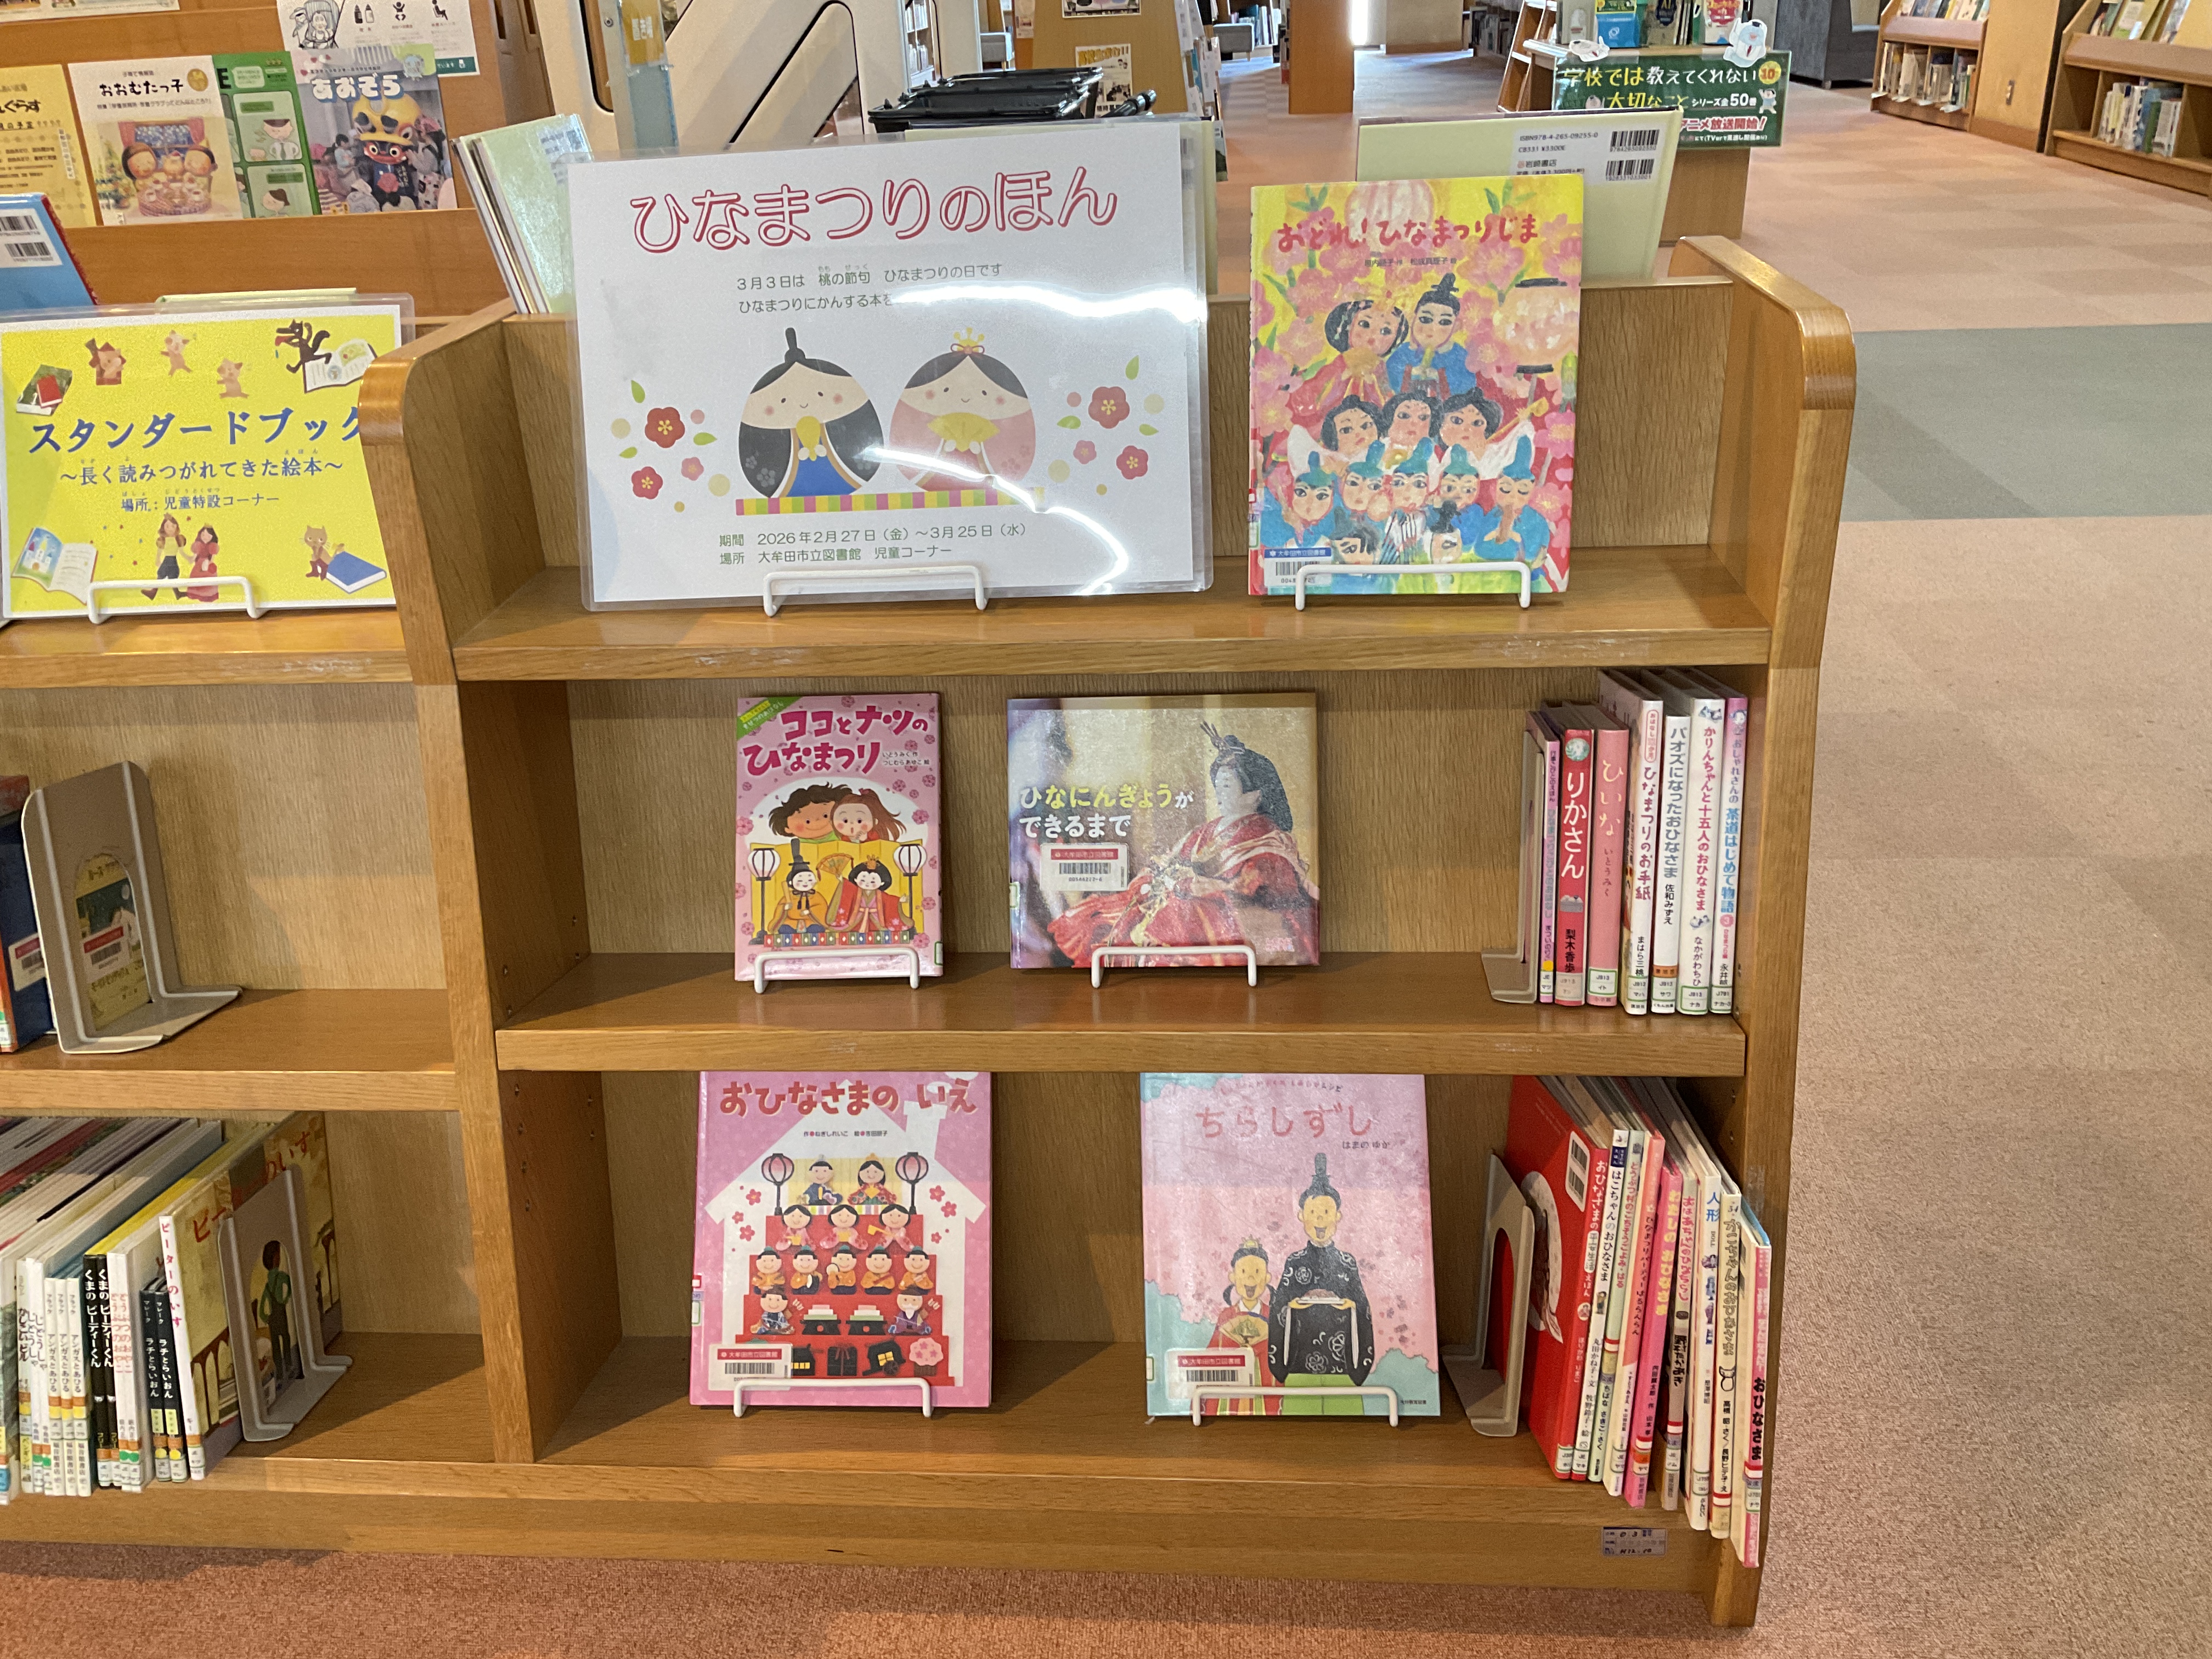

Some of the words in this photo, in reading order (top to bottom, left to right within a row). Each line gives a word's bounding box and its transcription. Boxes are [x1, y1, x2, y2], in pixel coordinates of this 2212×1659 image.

[99, 79, 183, 97] おおむたっ子
[311, 72, 402, 103] あおぞら
[1519, 132, 1599, 142] ISBN978-4-265-09255-0
[630, 166, 1118, 253] ひなまつりのほん
[737, 274, 805, 291] 3月3日は
[817, 269, 871, 287] 桃の節句
[884, 263, 1002, 283] ひなまつりの日です
[719, 533, 745, 547] 期間
[719, 551, 745, 566] 場所
[757, 548, 862, 563] 大牟田市立図書館
[873, 545, 952, 560] 児童コーナー
[781, 704, 928, 742] ココとナツの
[742, 741, 881, 776] ひなまつり
[1020, 783, 1194, 810] ひなにんぎょうが
[1598, 760, 1624, 837] ひいな
[1663, 727, 1688, 878] パオズになったおひなさま
[1019, 812, 1131, 839] できるまで
[1561, 771, 1588, 879] りかさん
[1635, 767, 1657, 900] ひなまつりのお手紙
[1695, 726, 1717, 911] かりんちゃんと十五人のおひなさま
[1602, 849, 1613, 898] いとうみく
[1720, 808, 1740, 913] 茶道はじめて物語
[1664, 883, 1675, 925] 佐和みずえ
[1564, 928, 1576, 973] 梨木香歩
[719, 1080, 901, 1117] おひなさまの
[916, 1076, 977, 1115] いえ
[1195, 1102, 1373, 1139] ちらしずし
[1600, 1170, 1622, 1282] はこちゃんのおひなさま
[1706, 1192, 1720, 1222] 人形
[84, 1269, 96, 1301] くまの
[98, 1269, 110, 1301] くまの
[161, 1222, 182, 1328] ピーターのいす
[86, 1305, 101, 1368] ビーティーくん
[145, 1337, 160, 1398] ラチとらいおん
[159, 1339, 173, 1400] ラチとらいおん
[1751, 1376, 1766, 1461] おひなさま
